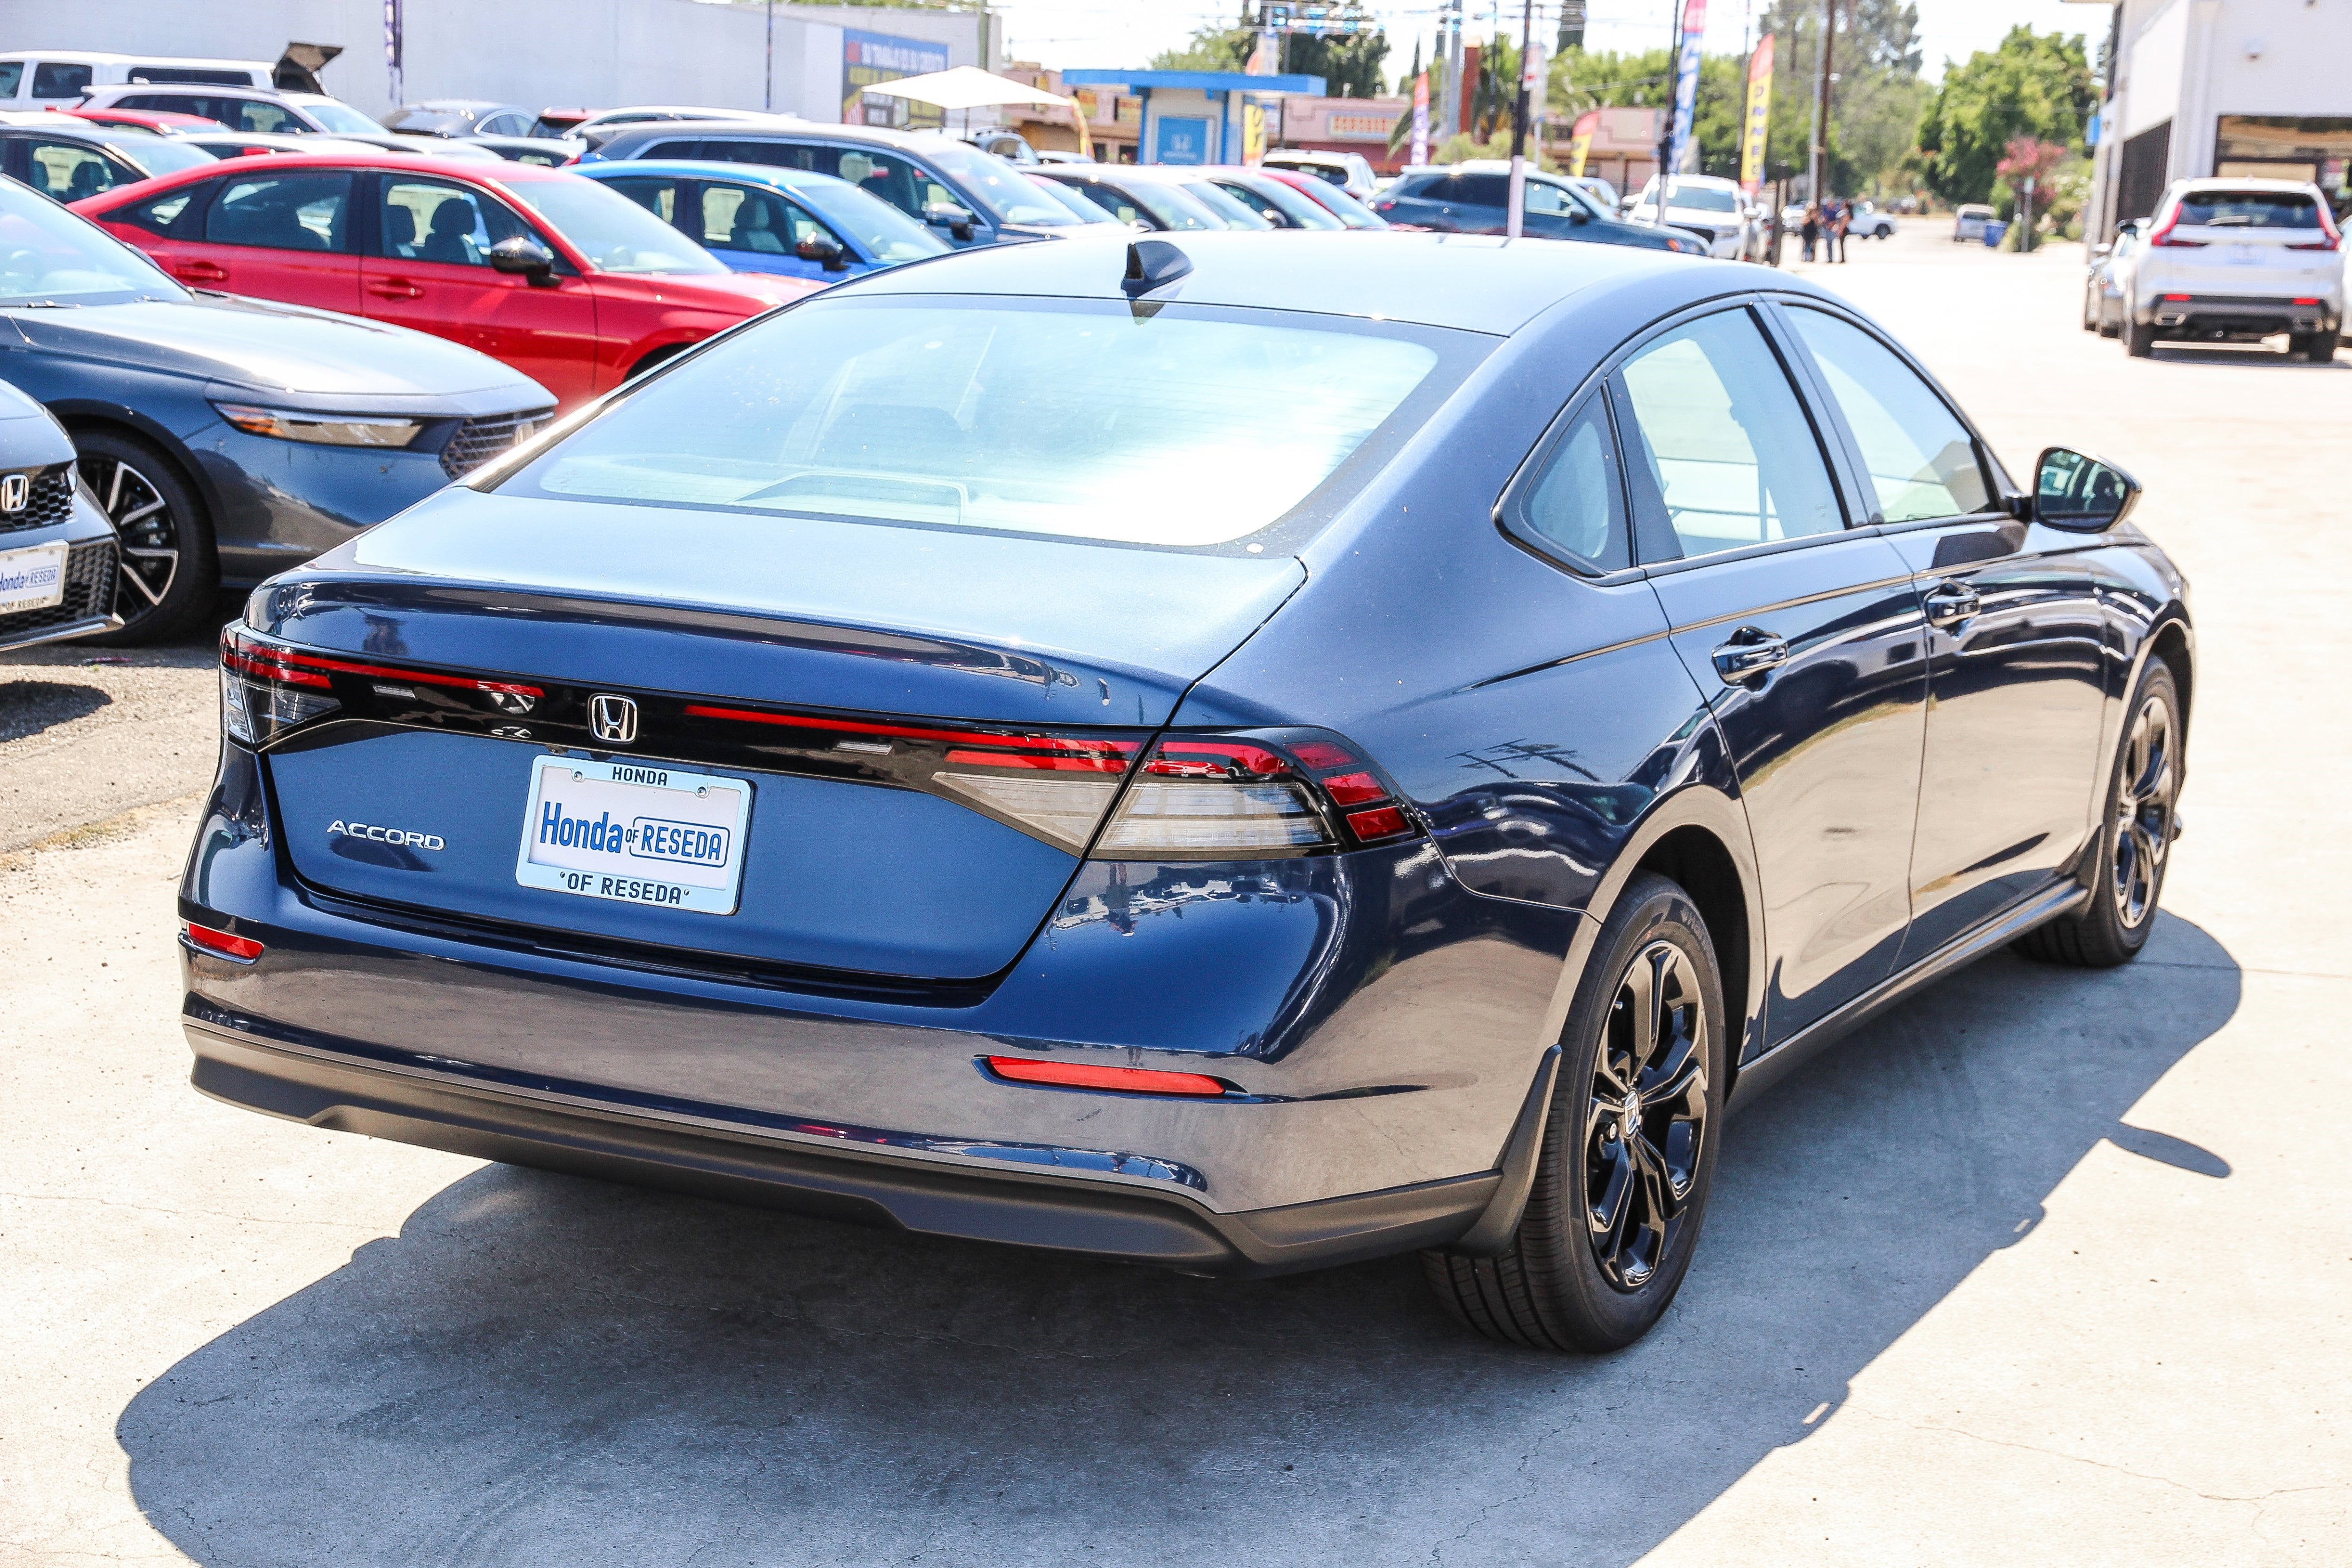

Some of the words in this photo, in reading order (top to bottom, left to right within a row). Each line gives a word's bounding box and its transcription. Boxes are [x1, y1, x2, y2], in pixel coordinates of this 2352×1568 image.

[612, 767, 668, 786] HONDA
[326, 820, 445, 851] ACCORD
[540, 801, 624, 853] Honda
[626, 828, 639, 844] OF
[641, 825, 723, 860] RESEDA
[567, 873, 593, 891] OF
[601, 877, 682, 905] RESEDA
